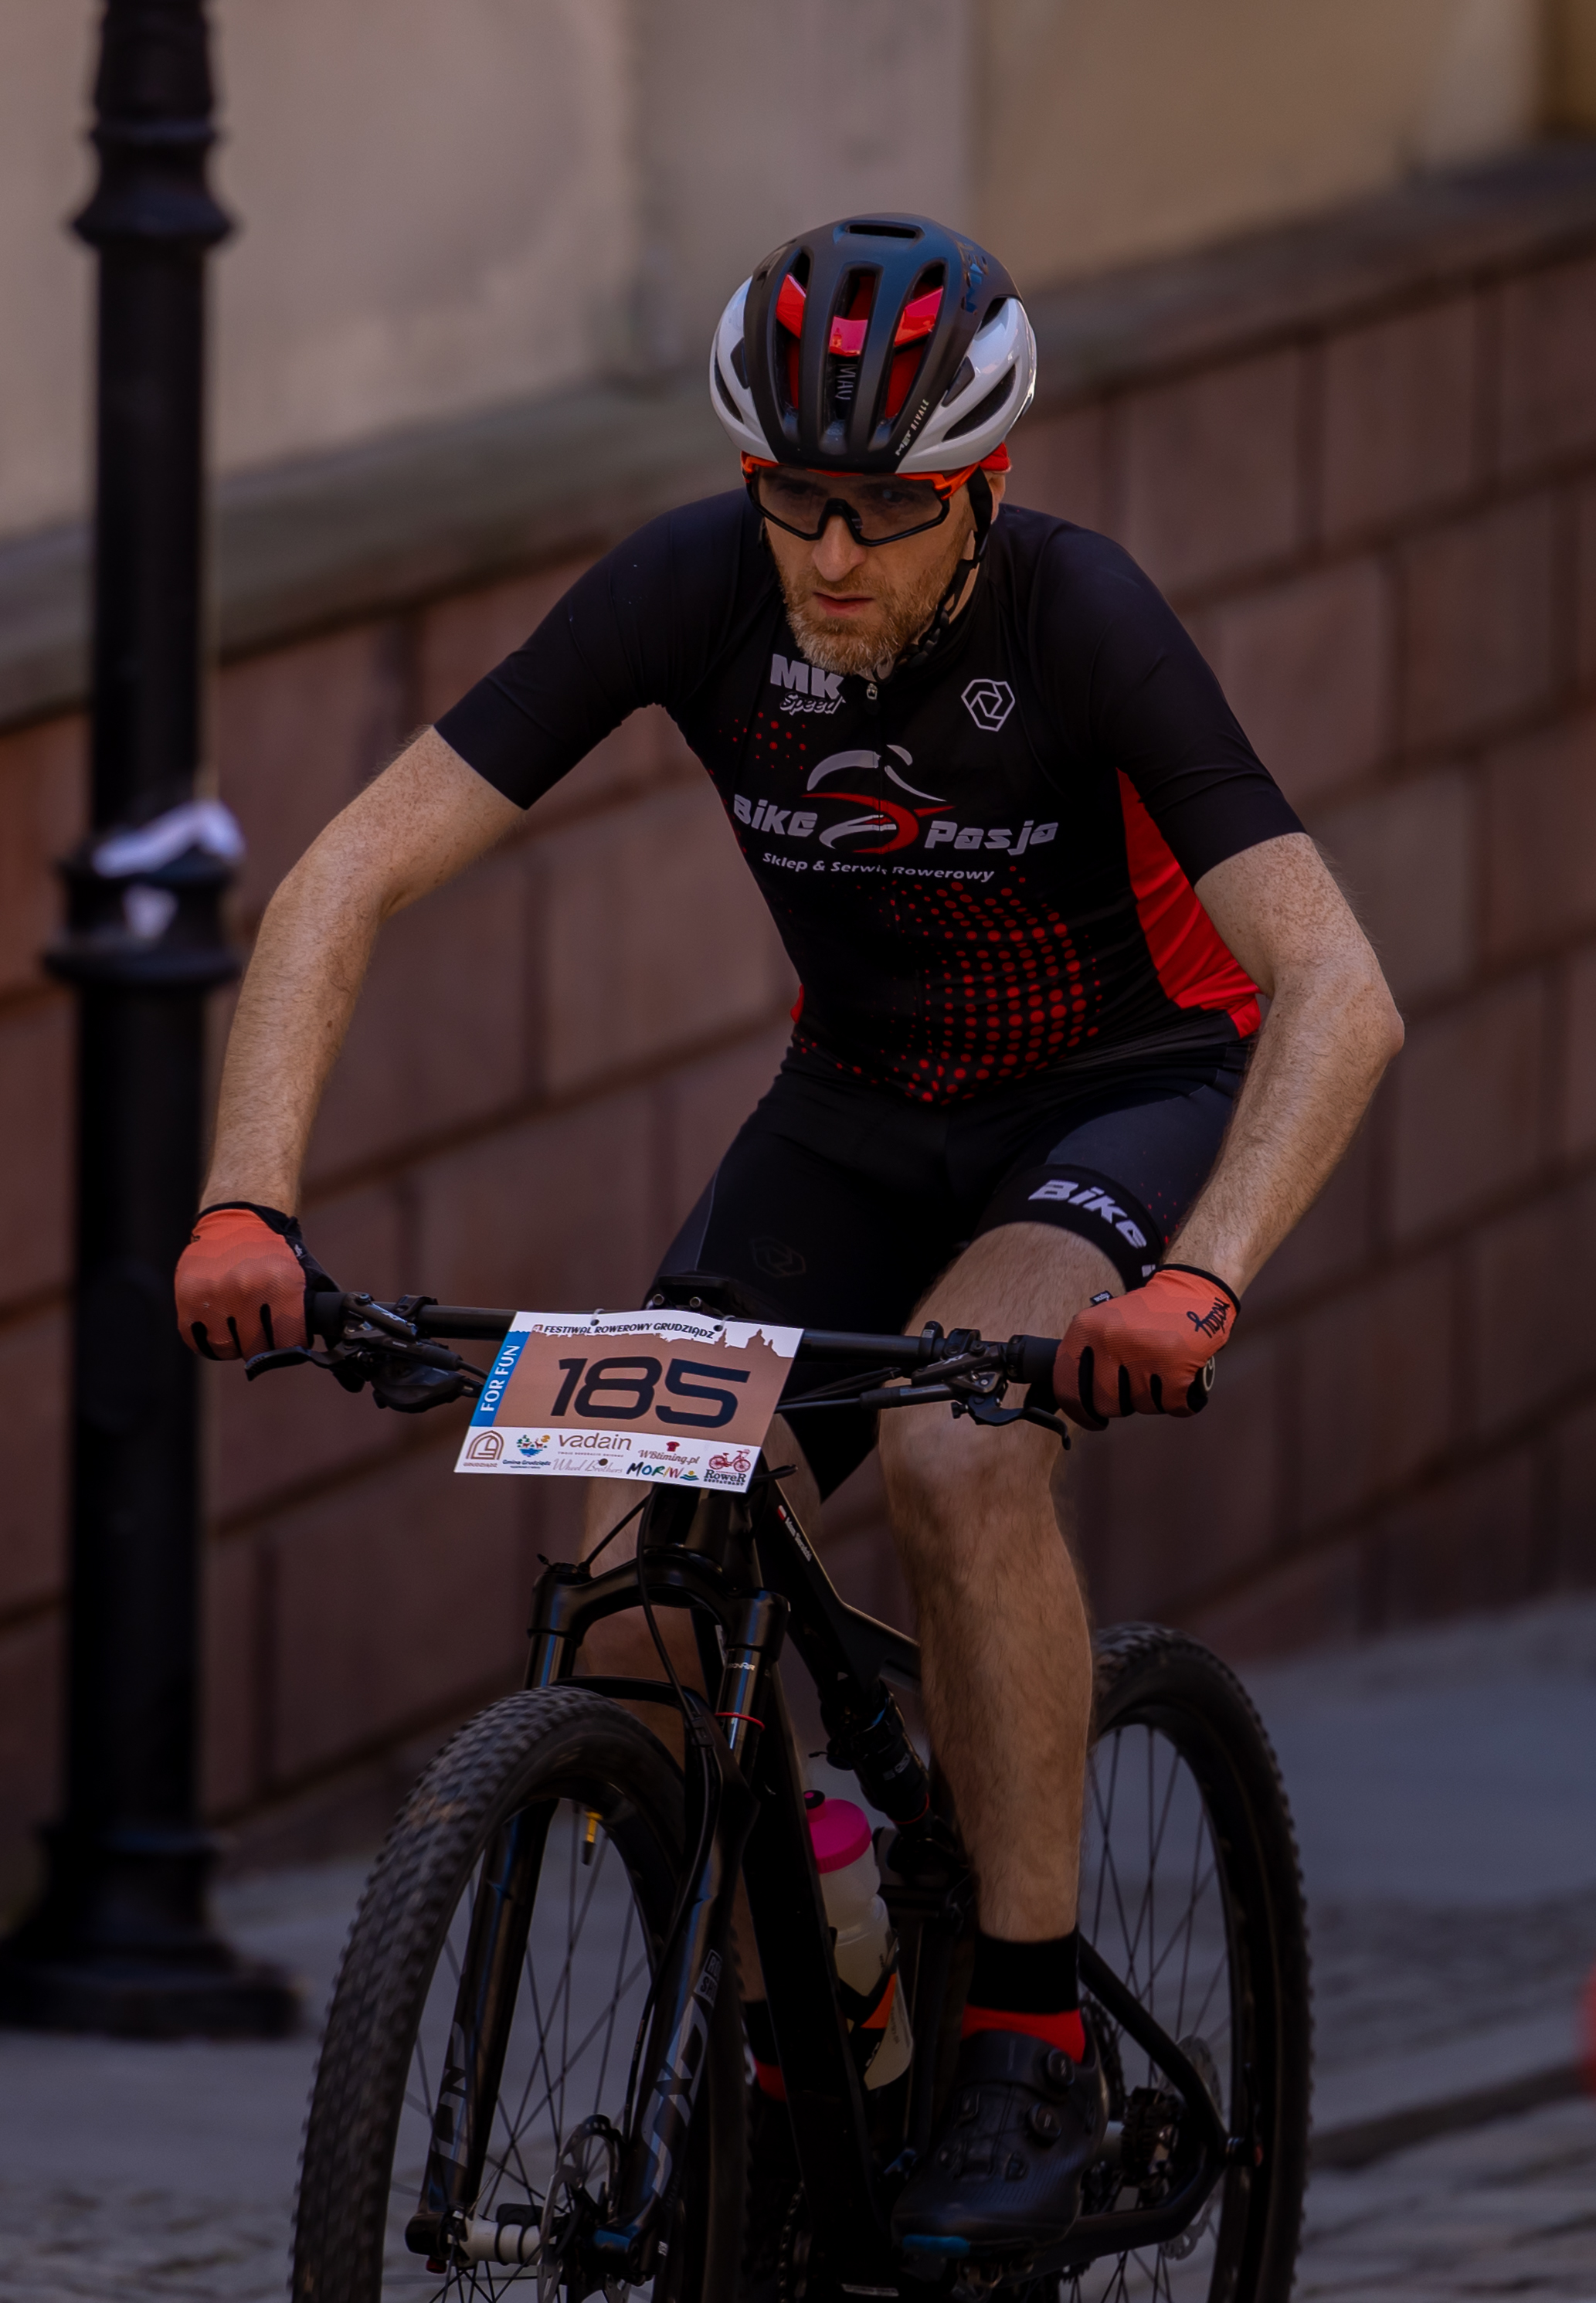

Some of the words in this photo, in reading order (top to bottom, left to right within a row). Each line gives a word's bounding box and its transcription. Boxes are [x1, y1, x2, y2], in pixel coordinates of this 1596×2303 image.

[770, 654, 844, 700] MK
[779, 691, 846, 715] Speed
[924, 820, 1059, 856] Pasja
[762, 852, 808, 872] Sklep
[813, 860, 826, 871] &
[891, 866, 994, 883] Rowerowy
[594, 1323, 652, 1333] ROWEROWY
[480, 1375, 505, 1411] FOR
[494, 1345, 520, 1375] FUN
[551, 1357, 750, 1428] 185
[559, 1433, 631, 1451] vadain
